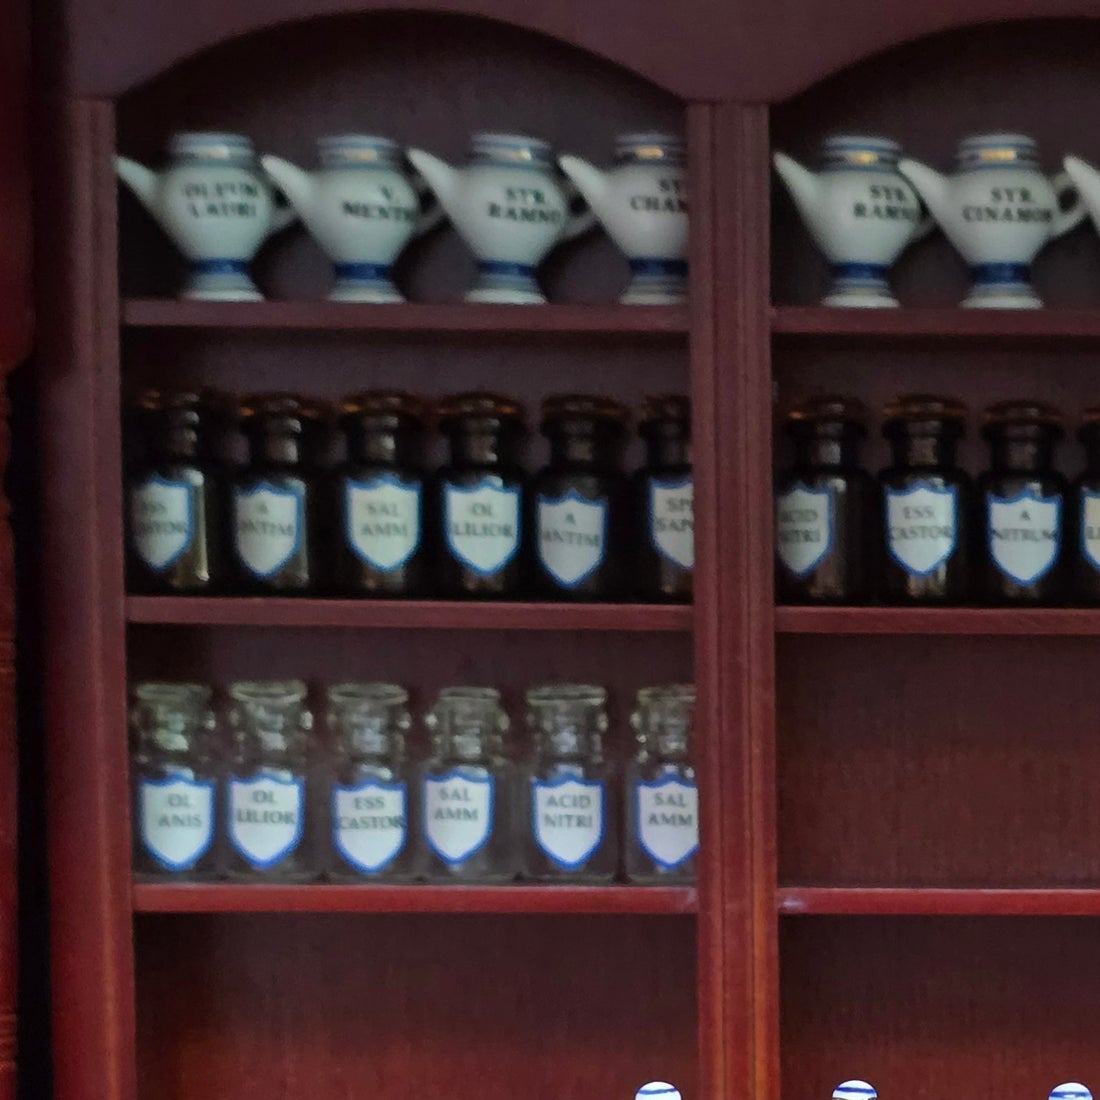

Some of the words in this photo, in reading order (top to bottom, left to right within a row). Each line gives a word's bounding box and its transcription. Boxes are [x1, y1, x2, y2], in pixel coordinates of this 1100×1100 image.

[564, 511, 577, 526] A
[166, 792, 191, 808] OL
[252, 789, 278, 804] OL
[438, 787, 470, 802] SAL
[545, 793, 592, 809] ACID
[650, 792, 684, 808] SAL
[353, 795, 386, 810] ESS
[156, 813, 202, 829] ANIS
[432, 807, 479, 822] AMM
[542, 813, 594, 829] NITRI
[645, 812, 694, 827] AMM
